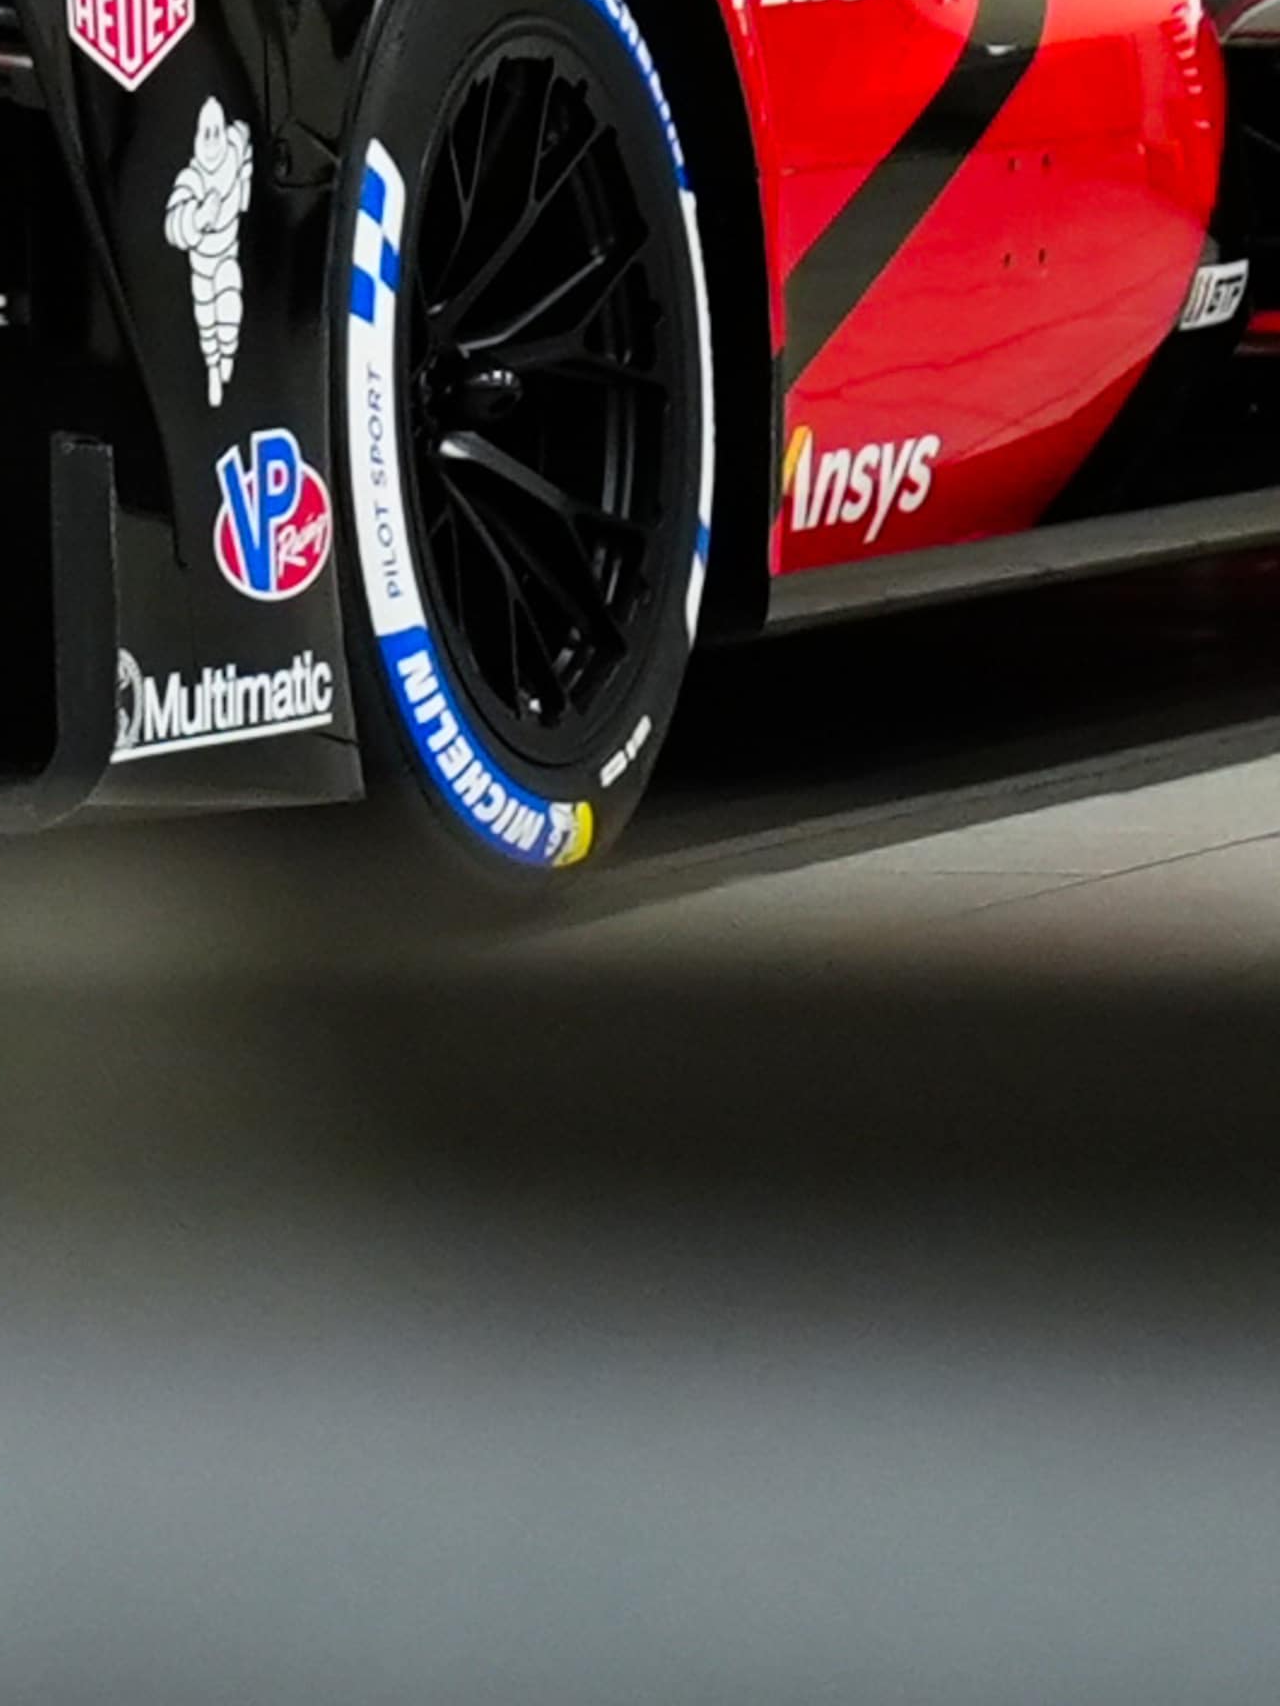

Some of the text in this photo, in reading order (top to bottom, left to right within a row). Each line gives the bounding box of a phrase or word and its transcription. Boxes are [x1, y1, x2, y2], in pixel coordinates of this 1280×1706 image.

[218, 429, 303, 593] VP
[365, 364, 402, 600] PILOT SPORT
[783, 425, 941, 545] Ansys
[143, 650, 333, 742] Multimatic
[398, 650, 547, 854] MICHELIN
